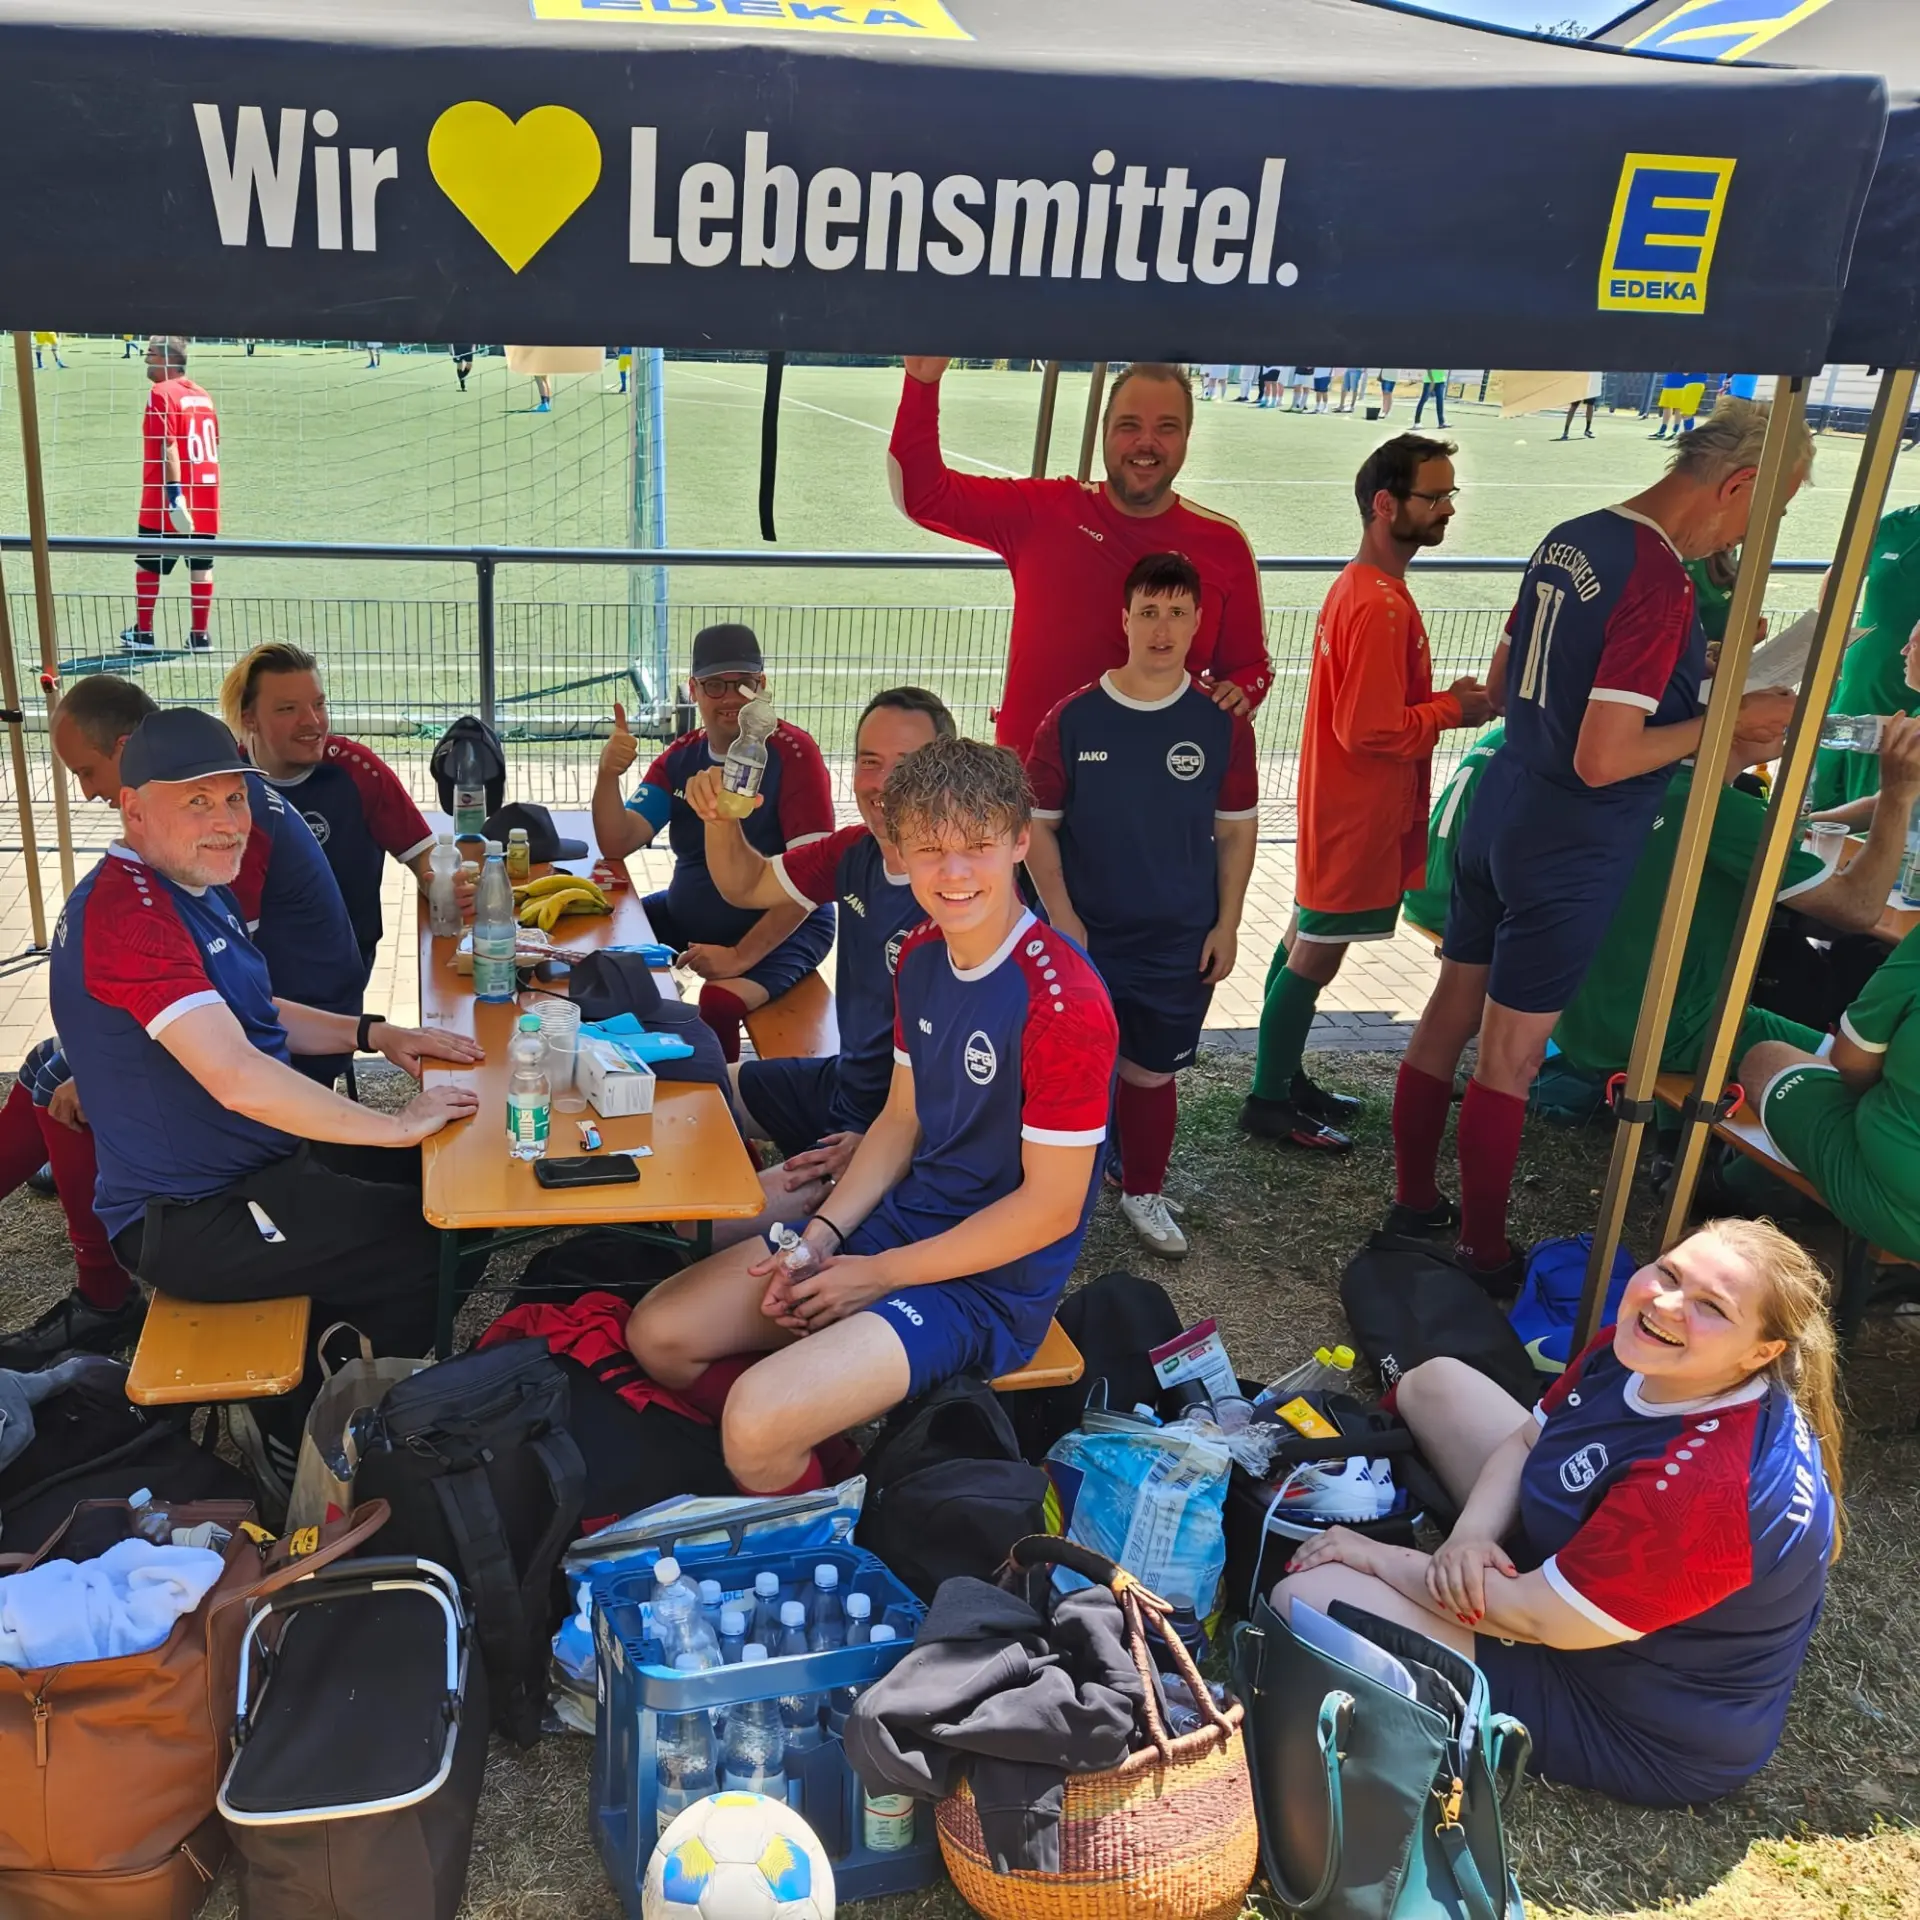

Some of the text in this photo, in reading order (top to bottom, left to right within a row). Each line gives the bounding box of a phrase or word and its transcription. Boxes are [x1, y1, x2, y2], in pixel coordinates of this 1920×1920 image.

[193, 103, 1299, 287] Wir Lebensmittel.
[1610, 280, 1697, 300] EDEKA
[187, 417, 218, 464] 60
[1519, 581, 1566, 709] 11
[1078, 751, 1108, 761] JAKO
[1171, 755, 1200, 766] SFG
[1775, 1074, 1805, 1100] JAKO
[886, 1298, 924, 1326] JAKO
[1574, 1448, 1597, 1485] SFG
[1786, 1464, 1814, 1524] LVR
